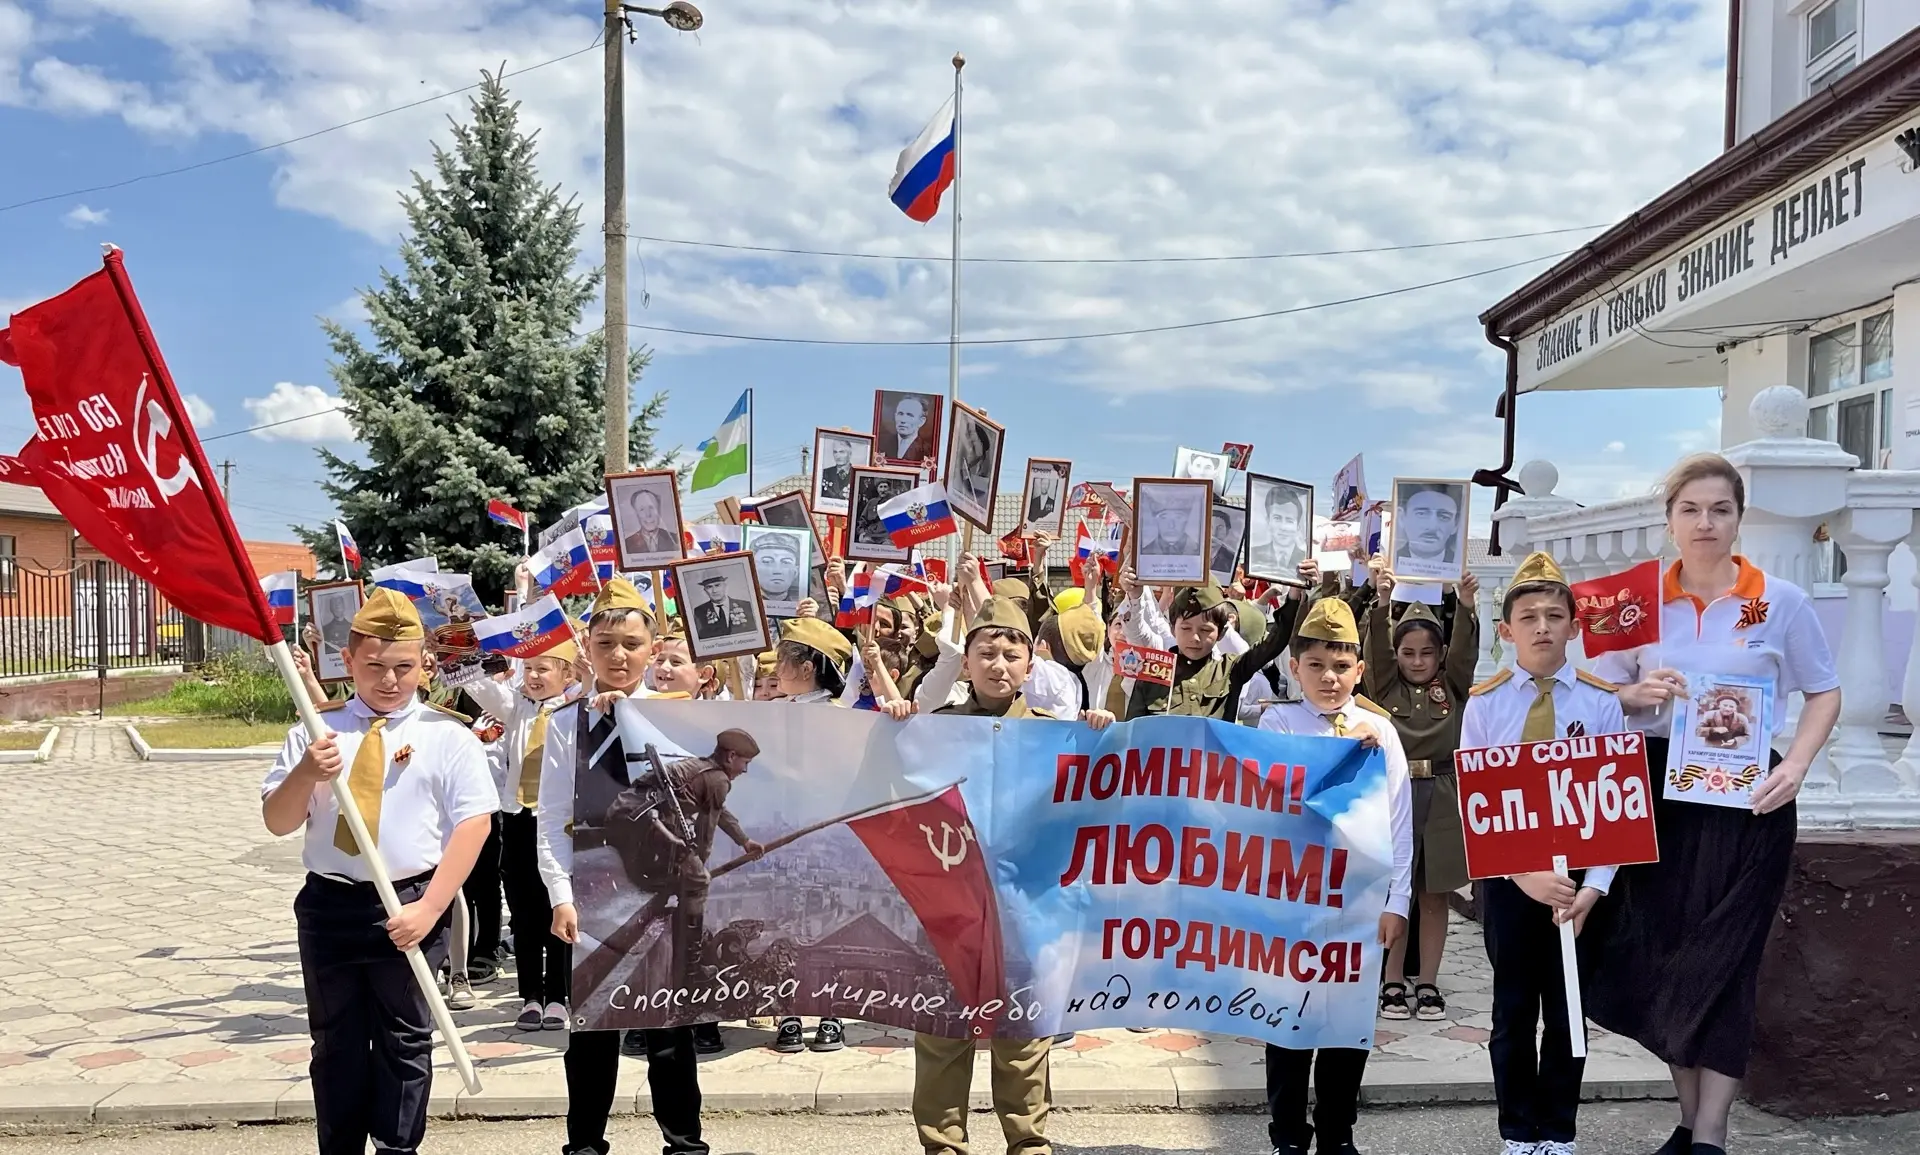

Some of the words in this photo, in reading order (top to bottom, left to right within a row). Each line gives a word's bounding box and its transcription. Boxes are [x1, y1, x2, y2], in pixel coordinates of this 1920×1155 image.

[1536, 314, 1583, 371] ЗНАНИЕ
[1589, 306, 1600, 346] И
[1606, 268, 1667, 338] ТОЛЬКО
[1678, 218, 1755, 302] ЗНАНИЕ
[1770, 158, 1867, 266] ДЕЛАЕТ
[1145, 651, 1173, 664] ПОБЕДА
[1054, 748, 1306, 814] ПОМНИМ!
[1461, 746, 1521, 772] МОУ
[1532, 737, 1597, 763] СОШ
[1467, 788, 1539, 834] с.п.
[1547, 762, 1648, 840] Куба
[1060, 824, 1348, 907] ЛЮБИМ!
[1102, 917, 1362, 983] ГОРДИМСЯ!
[608, 964, 749, 1012] Спасибо
[755, 978, 800, 1014] за
[811, 980, 947, 1016] мирное
[958, 985, 1043, 1021] небо
[1067, 973, 1132, 1012] над
[1147, 987, 1311, 1032] головой!
